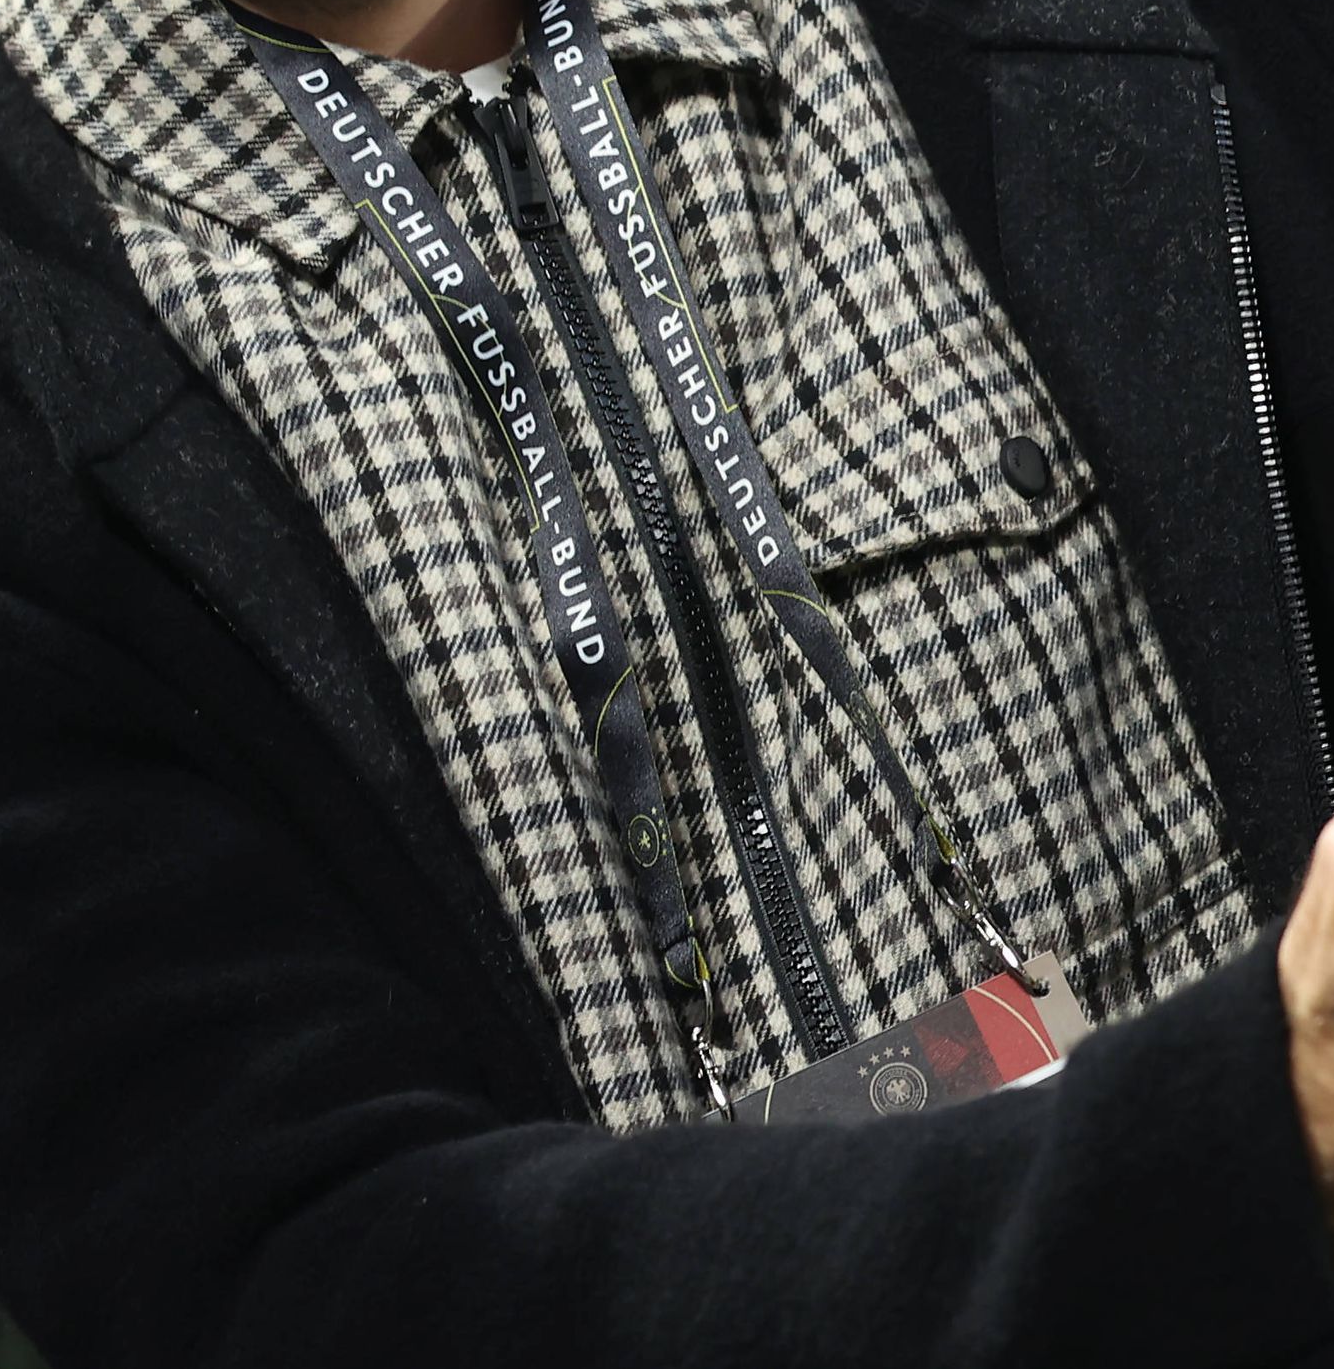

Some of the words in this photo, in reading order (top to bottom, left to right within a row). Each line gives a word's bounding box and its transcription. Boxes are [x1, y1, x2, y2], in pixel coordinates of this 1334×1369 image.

[297, 68, 465, 294] DEUTSCHER
[457, 303, 605, 665] FUSSBALL-BUND
[658, 308, 780, 567] DEUTSCHER
